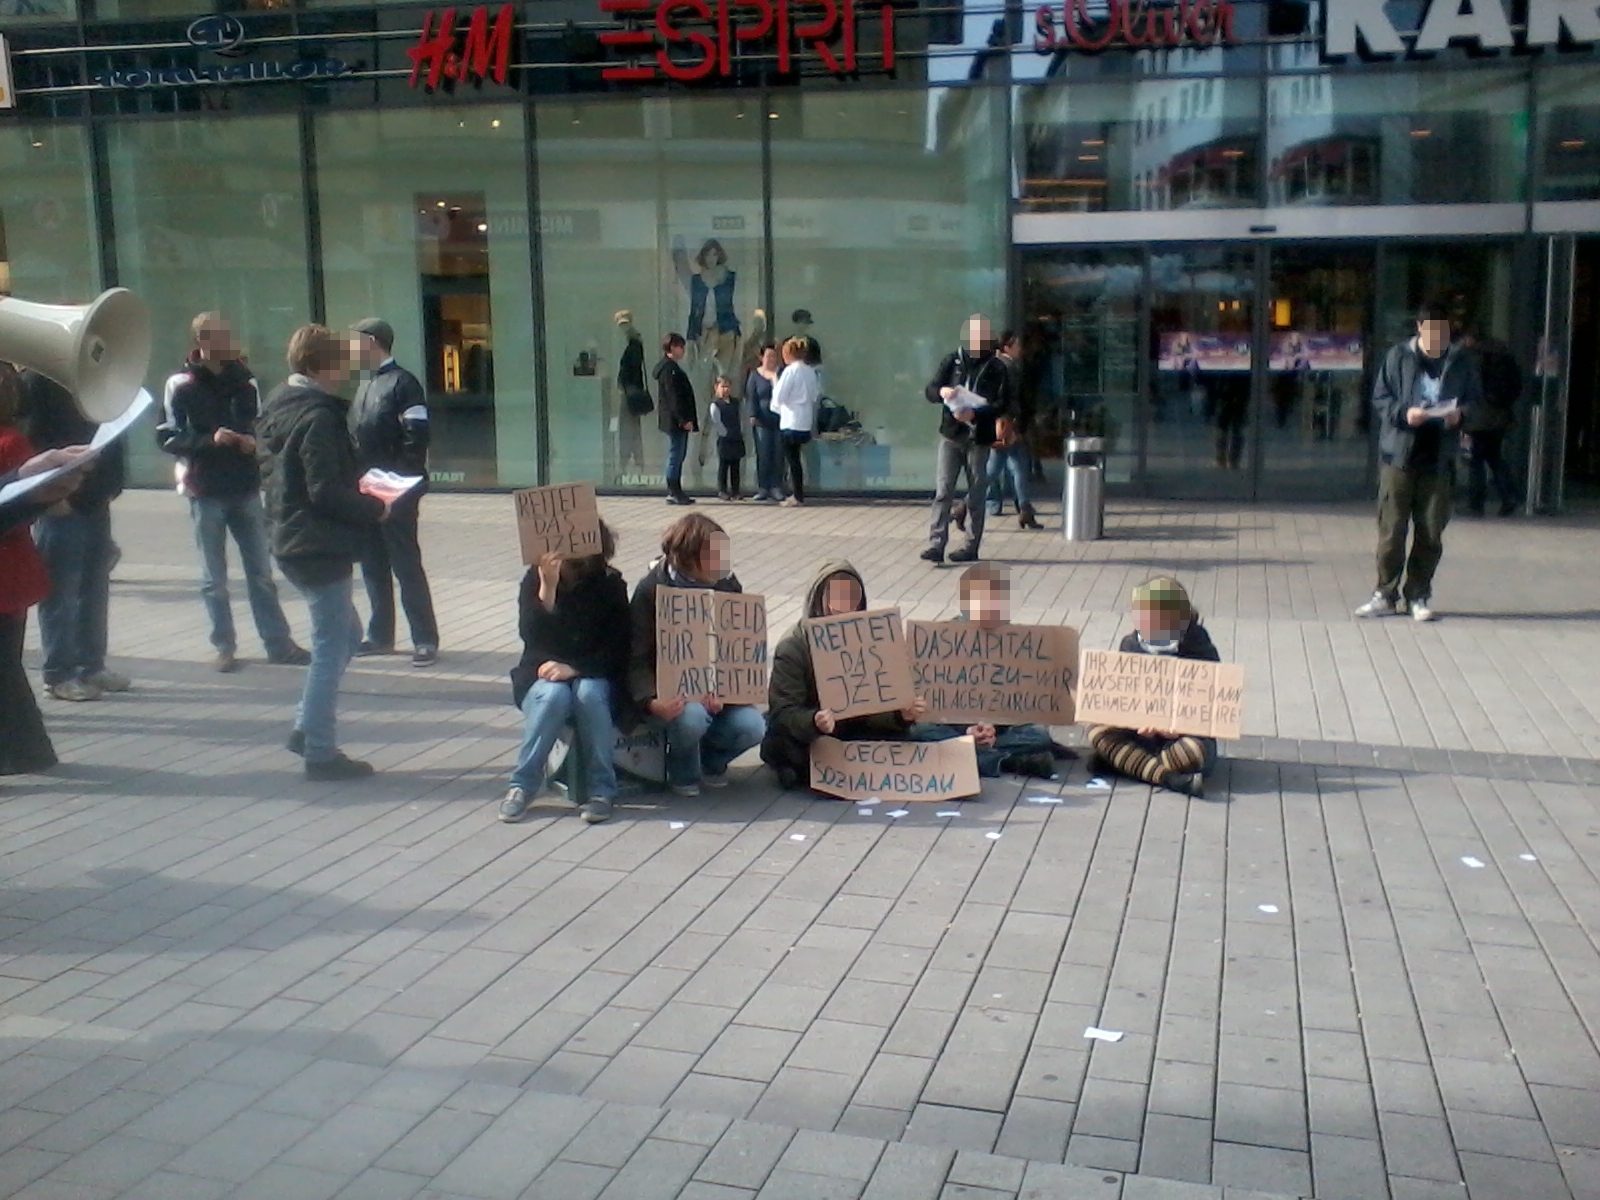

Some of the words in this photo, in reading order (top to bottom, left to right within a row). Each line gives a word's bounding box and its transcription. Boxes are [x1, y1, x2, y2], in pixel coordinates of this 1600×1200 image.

[406, 3, 514, 89] H&M
[518, 485, 583, 517] RETTET
[658, 593, 716, 633] MEHR
[720, 599, 767, 635] GELD
[812, 613, 897, 651] RETTET
[840, 646, 884, 674] DAS
[1085, 651, 1108, 676] IHR
[1114, 654, 1171, 678] NEHMT
[826, 671, 897, 714] JZE
[1080, 692, 1141, 714] NEHMEN
[1144, 698, 1168, 717] WIR
[843, 743, 929, 766] GEGEN
[813, 760, 956, 795] SOZIALABBAU
